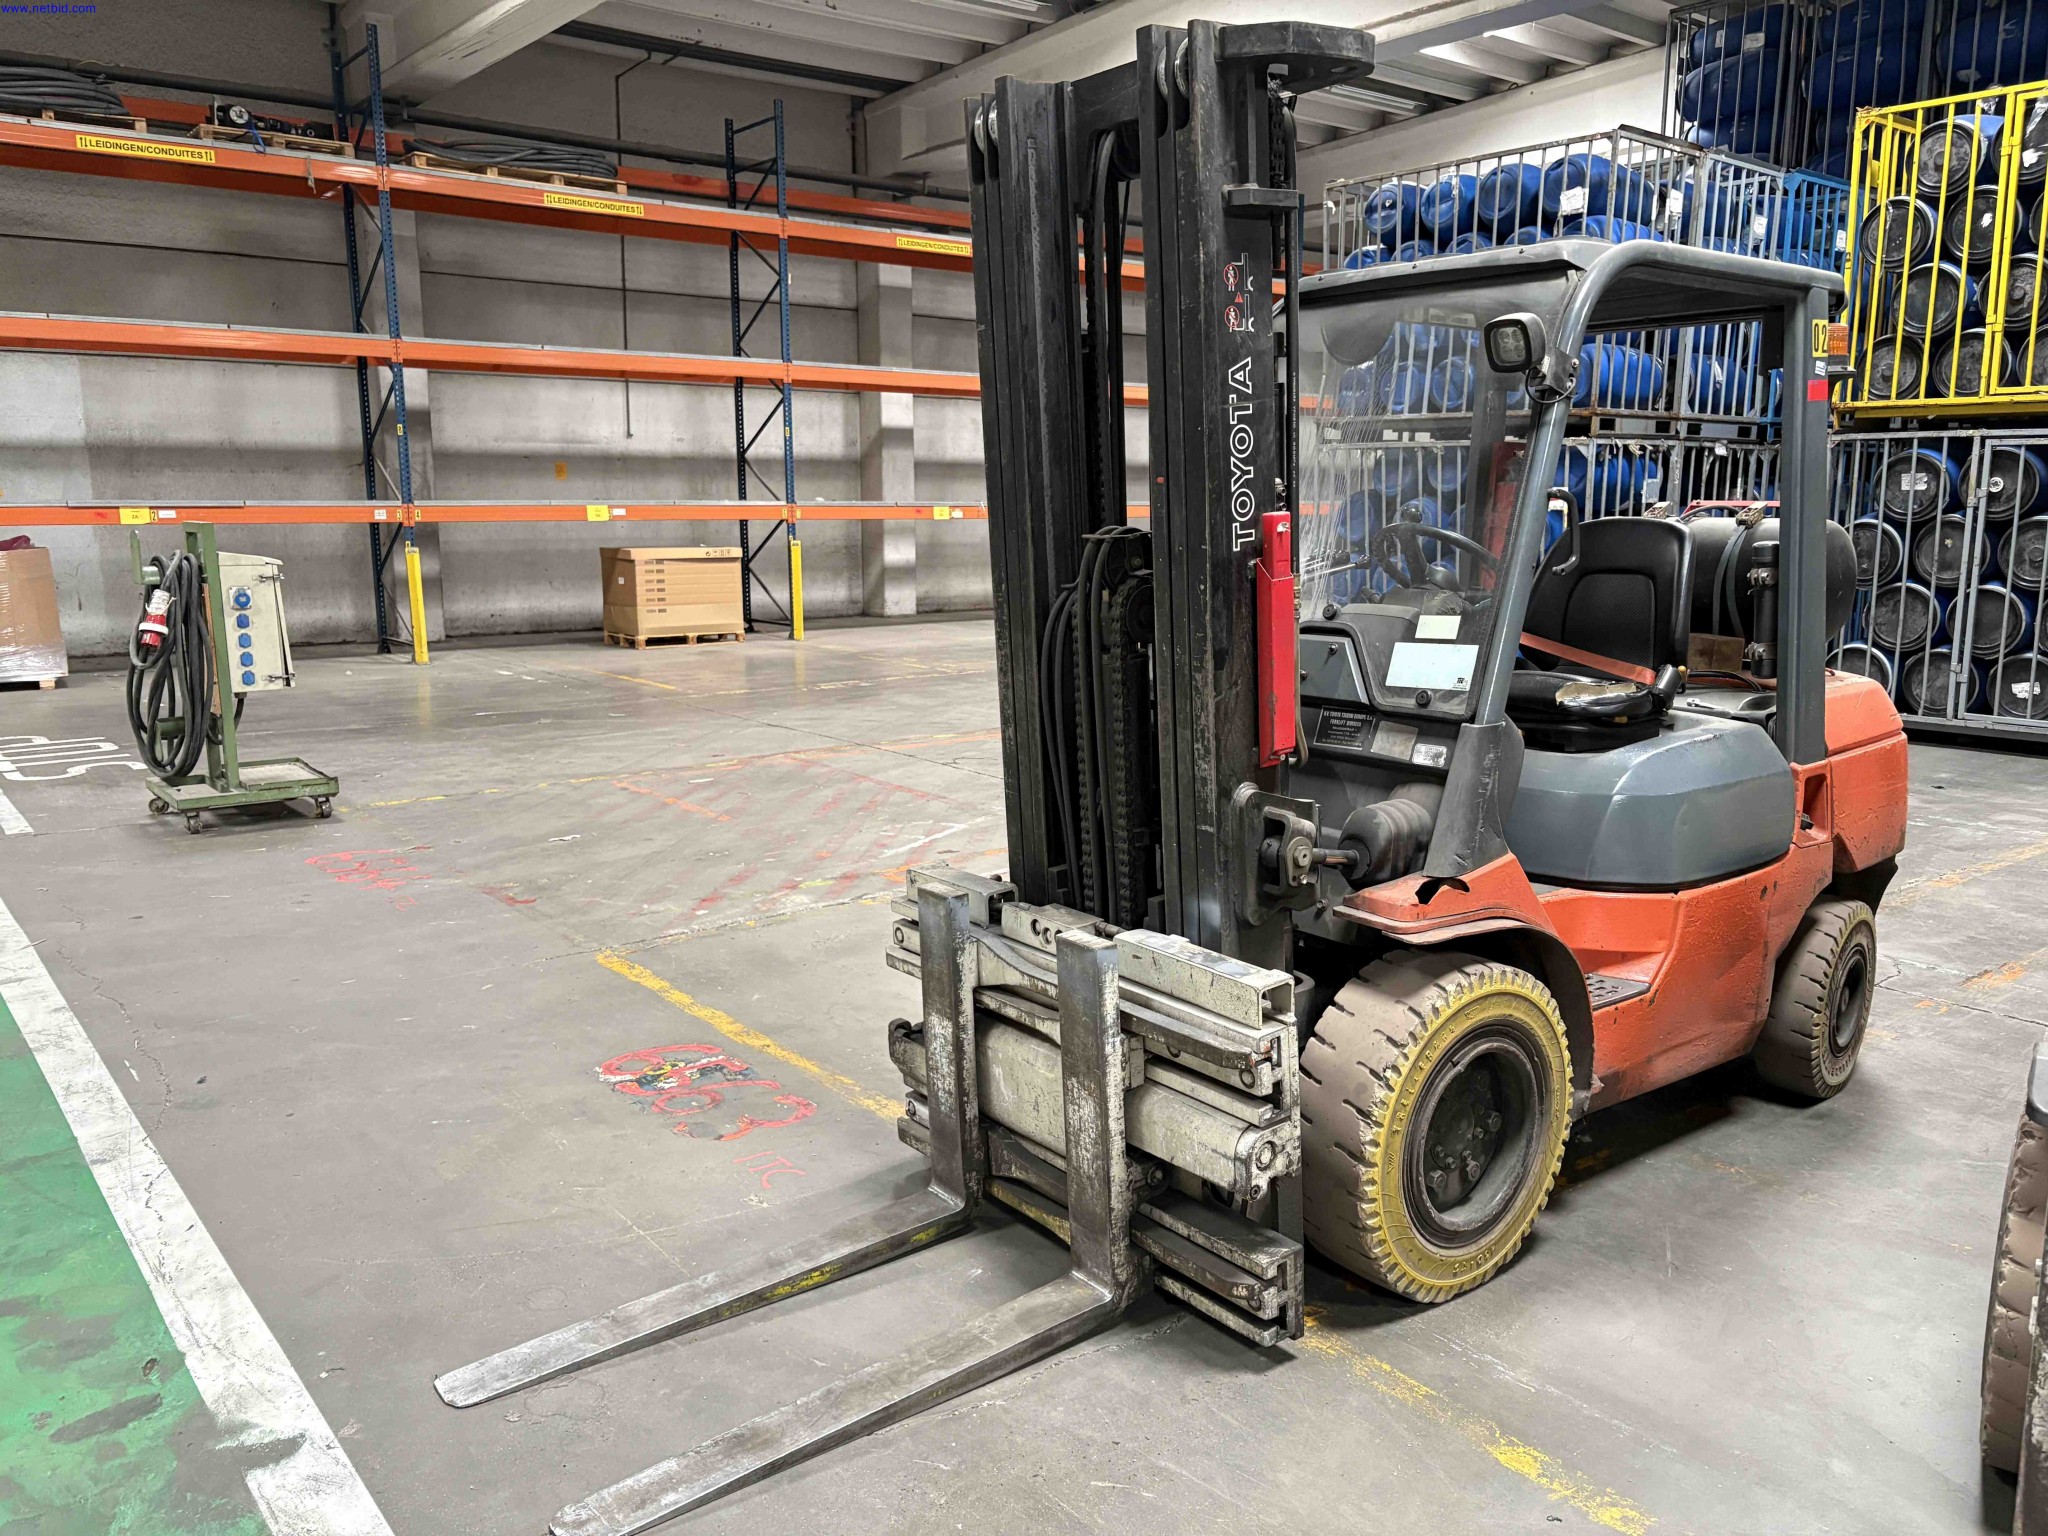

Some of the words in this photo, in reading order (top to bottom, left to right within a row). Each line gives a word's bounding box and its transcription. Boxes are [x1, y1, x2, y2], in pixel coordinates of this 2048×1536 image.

[88, 139, 204, 160] LEIDINGEN/CONDUITES
[552, 197, 636, 213] LEIDINGEN/CONDUITES
[1814, 322, 1828, 354] 02
[1228, 357, 1255, 551] TOYOTA
